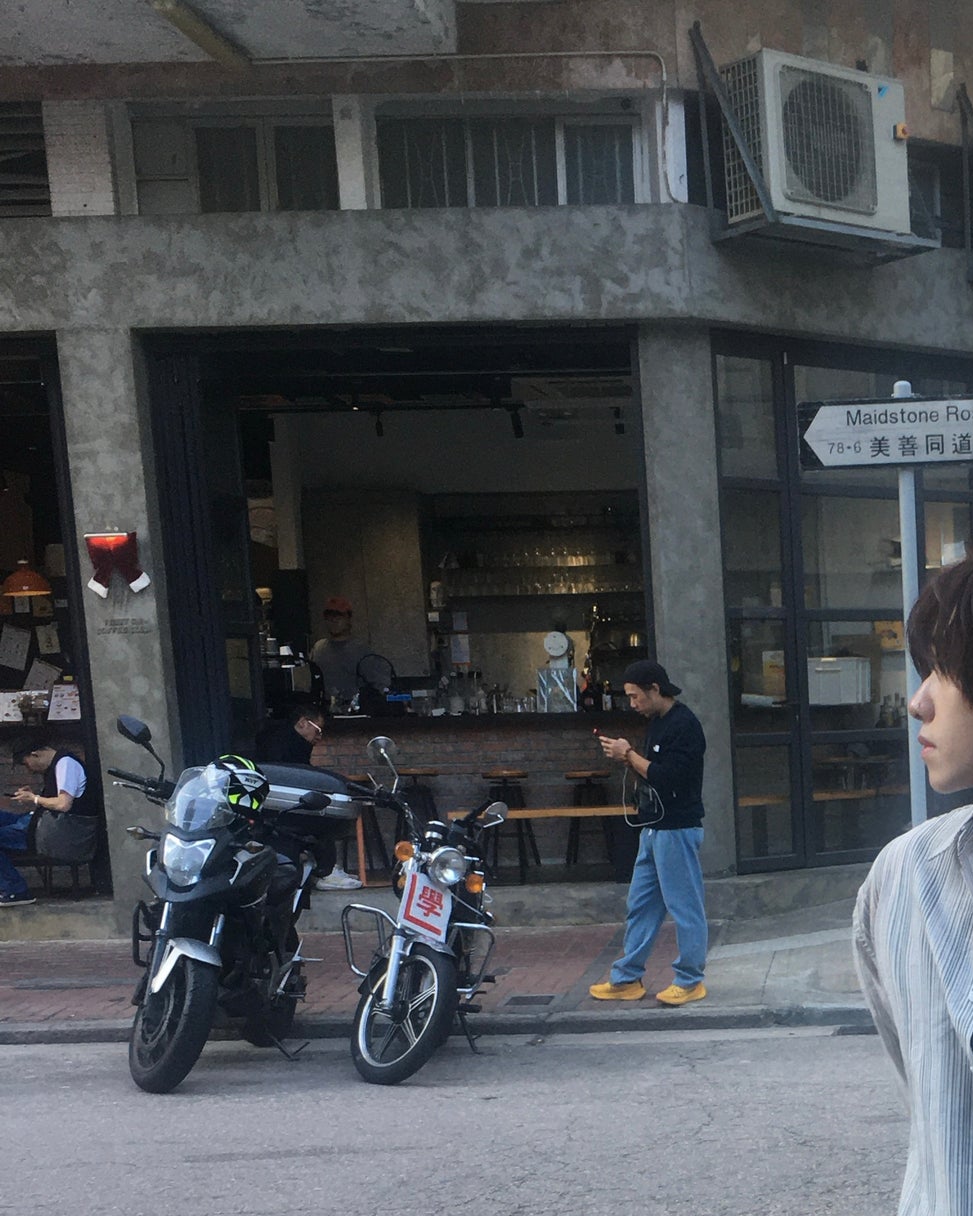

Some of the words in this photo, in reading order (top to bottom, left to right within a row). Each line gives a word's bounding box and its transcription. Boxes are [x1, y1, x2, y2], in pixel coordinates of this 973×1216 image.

[846, 408, 939, 426] Maidstone
[869, 432, 973, 458] 美善同道
[416, 886, 443, 917] 學
